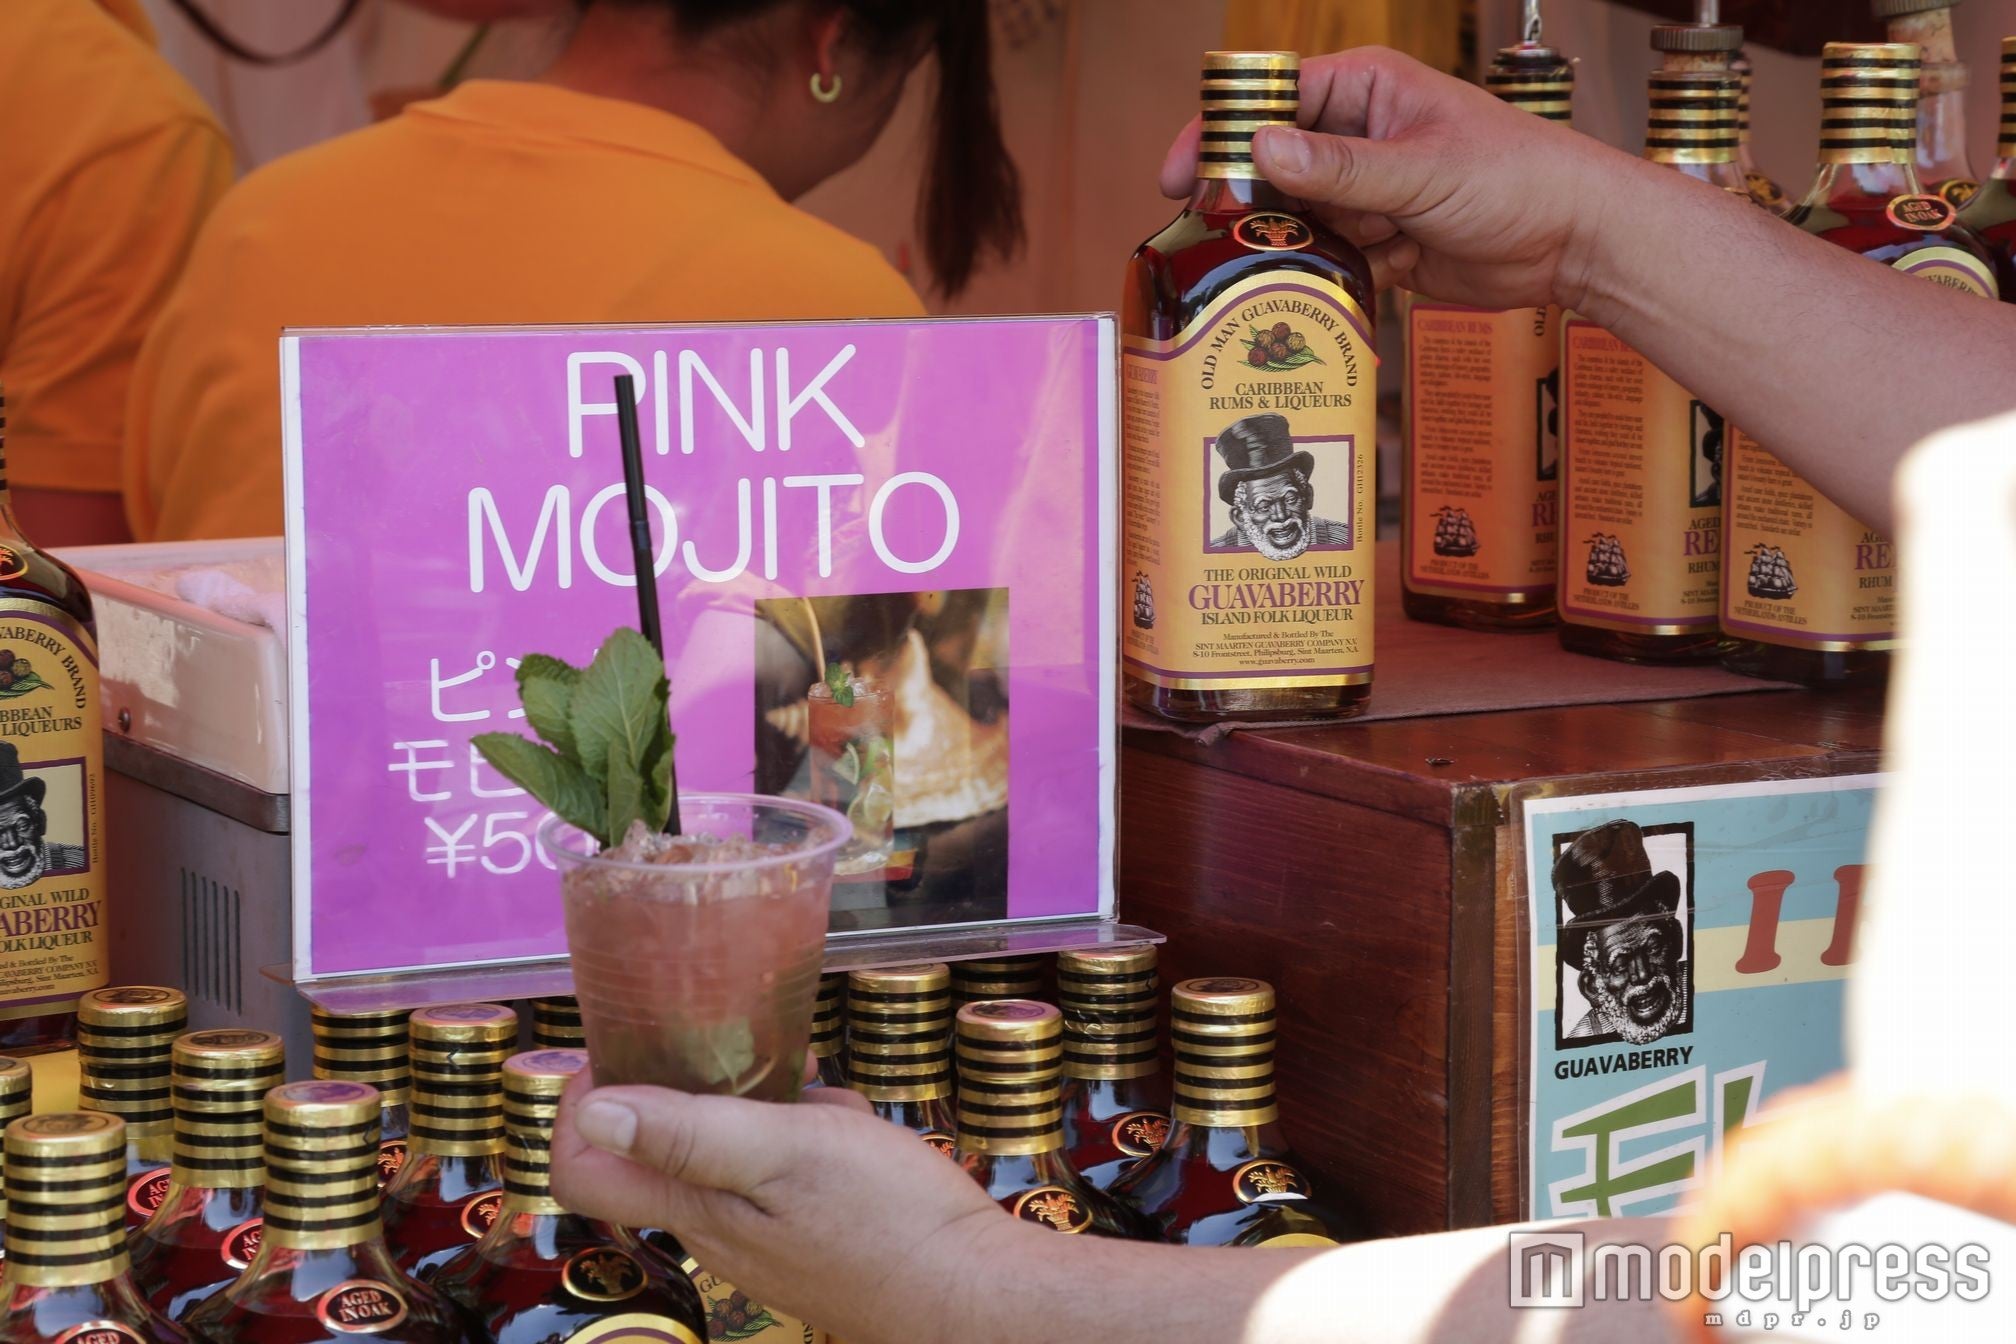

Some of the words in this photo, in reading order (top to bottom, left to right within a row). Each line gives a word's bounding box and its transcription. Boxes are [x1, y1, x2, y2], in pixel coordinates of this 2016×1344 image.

[1201, 354, 1217, 390] OLD
[1210, 317, 1241, 353] MAN
[1242, 299, 1339, 331] GUAVABERRY
[1334, 331, 1358, 387] BRAND
[1235, 381, 1323, 396] CARIBBEAN
[567, 343, 865, 458] PINK
[1209, 396, 1253, 410] RUMS
[1258, 396, 1270, 409] &
[1275, 394, 1352, 411] LIQUEURS
[467, 470, 961, 594] MOJITO
[1204, 569, 1234, 581] THE
[1238, 567, 1310, 581] ORIGINAL
[1314, 565, 1352, 578] WILD
[1188, 580, 1365, 610] GUAVABERRY
[1202, 612, 1250, 624] ISLAND
[1254, 611, 1289, 623] FOLK
[1293, 609, 1353, 624] LIQUEUR
[1223, 631, 1272, 640] Manufactured
[1281, 630, 1308, 639] Bottled
[1321, 629, 1334, 638] The
[1195, 642, 1214, 650] SINT
[1216, 641, 1253, 650] MAARTEN
[1255, 639, 1305, 649] GUAVABERRY
[61, 656, 86, 709] BRAND
[2, 717, 82, 737] LIQUEURS
[50, 888, 90, 903] WILD
[29, 931, 93, 950] LIQUEUR
[1554, 1045, 1694, 1080] GUAVABERRY
[340, 1291, 381, 1309] AGED
[340, 1304, 358, 1322] IN
[358, 1301, 392, 1318] OAK
